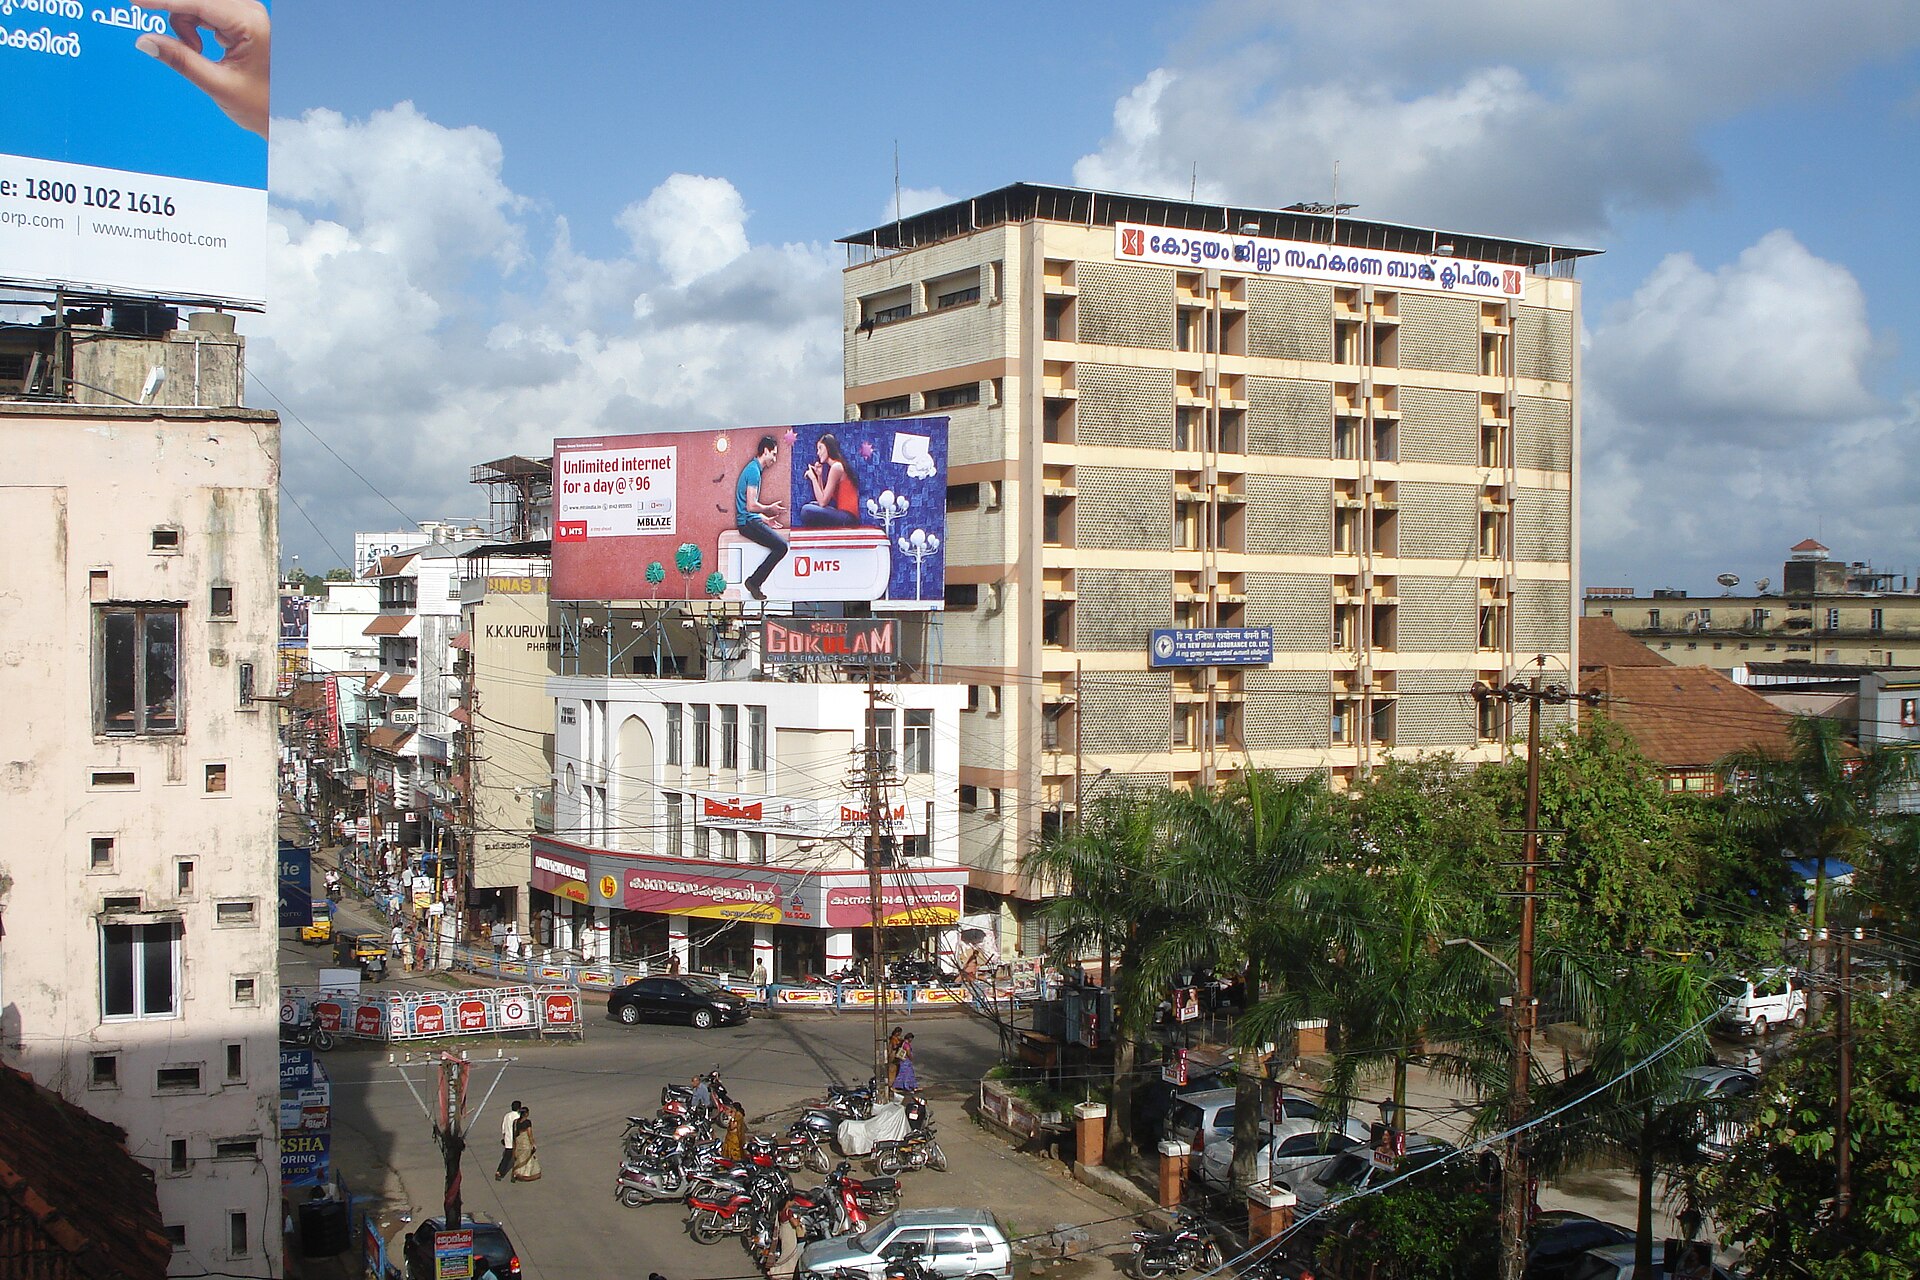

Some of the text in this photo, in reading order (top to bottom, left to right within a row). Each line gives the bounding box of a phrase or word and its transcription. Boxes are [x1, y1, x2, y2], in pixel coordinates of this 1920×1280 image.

[92, 5, 166, 34] പലിശ
[25, 178, 77, 203] 1800
[83, 186, 121, 210] 102
[127, 192, 176, 216] 1616
[0, 210, 64, 229] orp.com
[92, 221, 227, 248] www.muthoot.com
[1150, 235, 1229, 264] കോട്ടയം
[1234, 240, 1280, 272] ജില്ലാ
[1285, 249, 1382, 276] സഹകരണ
[1387, 258, 1437, 281] ബാങ്ക്
[1440, 262, 1500, 290] ക്ലിപ്തം
[563, 455, 671, 475] Unlimited internet
[563, 480, 581, 494] for
[583, 483, 590, 493] a
[637, 517, 672, 528] MBLAZE
[568, 527, 583, 536] MTS
[813, 560, 840, 572] MTS
[811, 622, 848, 634] SREE
[766, 620, 893, 654] GOKULAM
[526, 642, 576, 652] PHARMCY
[394, 713, 415, 723] BAR
